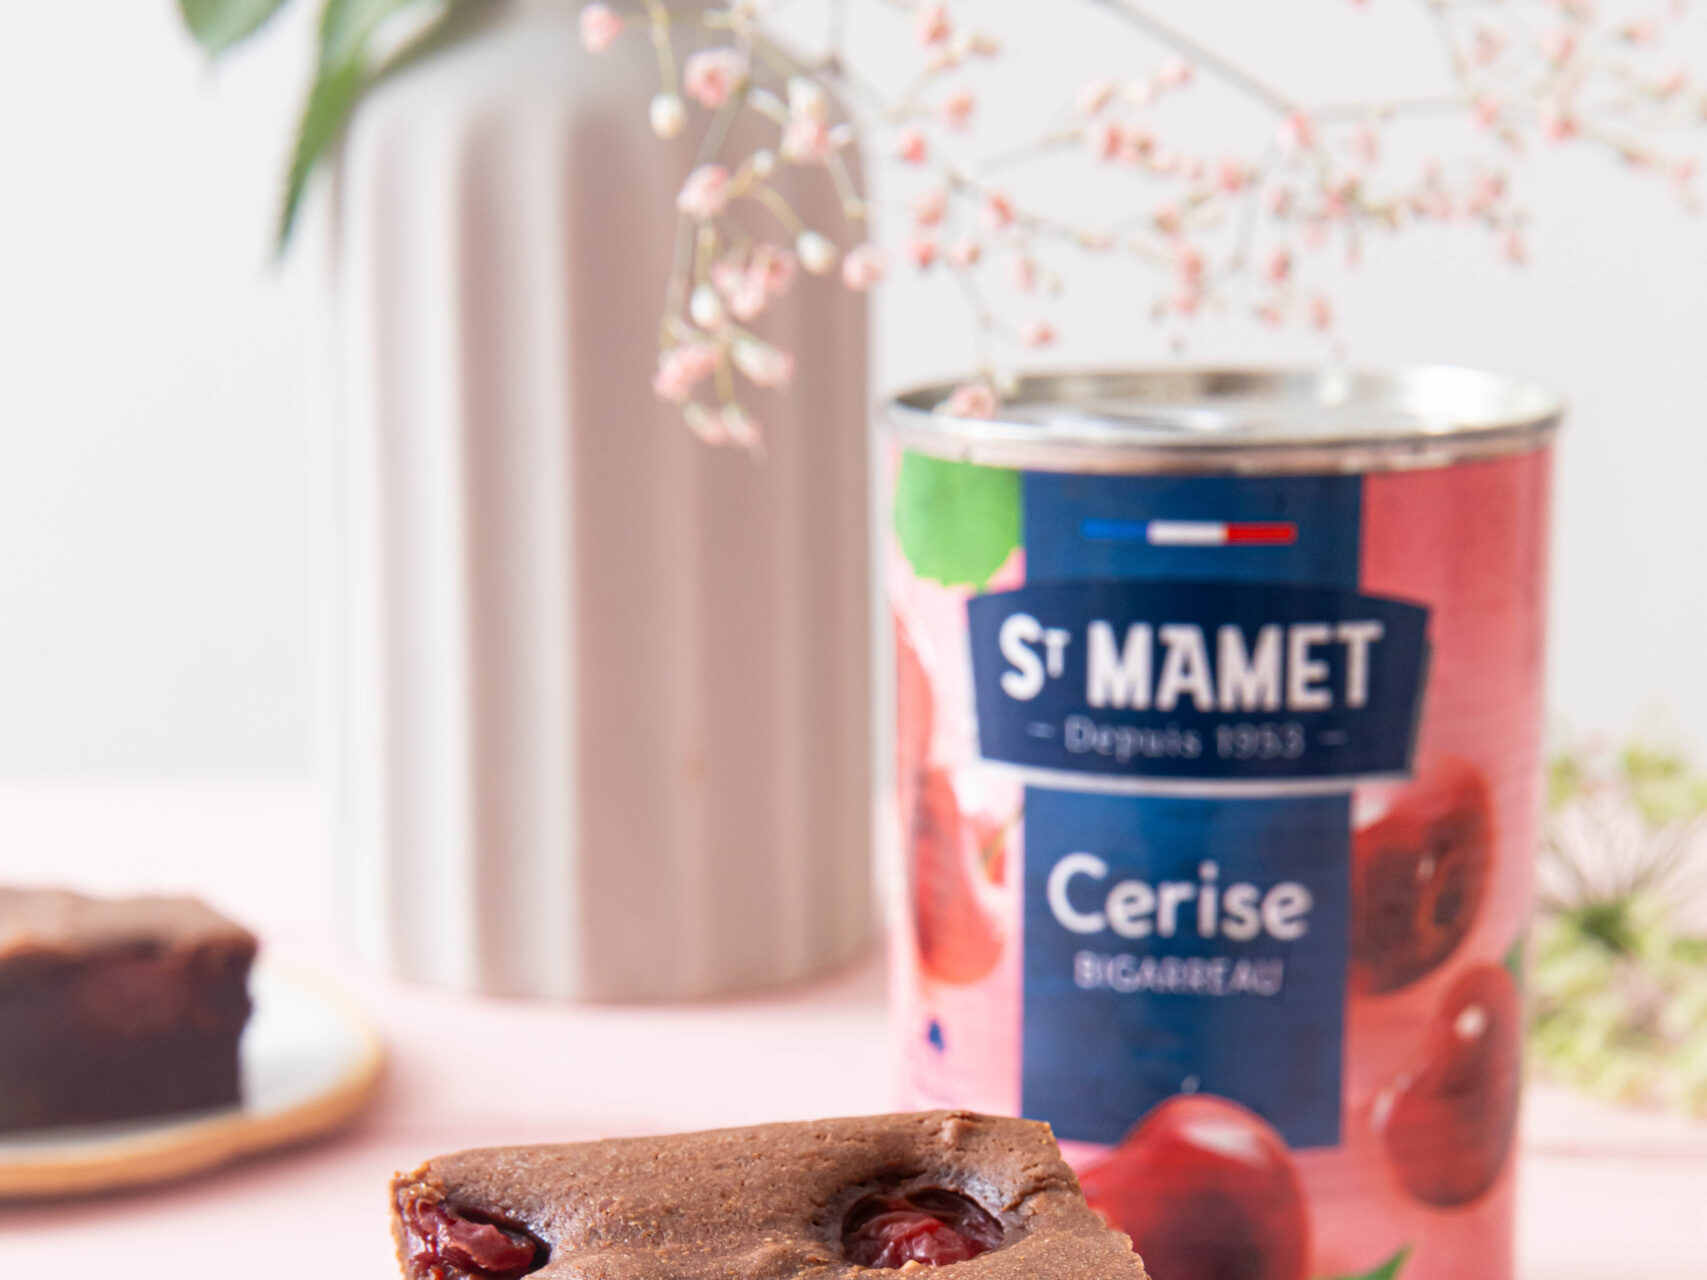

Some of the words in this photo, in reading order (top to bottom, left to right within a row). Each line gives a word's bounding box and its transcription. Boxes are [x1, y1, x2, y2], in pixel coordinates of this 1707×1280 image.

[1086, 620, 1385, 712] MAMET
[1063, 714, 1203, 763] Depuis
[1047, 852, 1313, 942] Cerise
[1073, 950, 1285, 996] BIGARREAU
